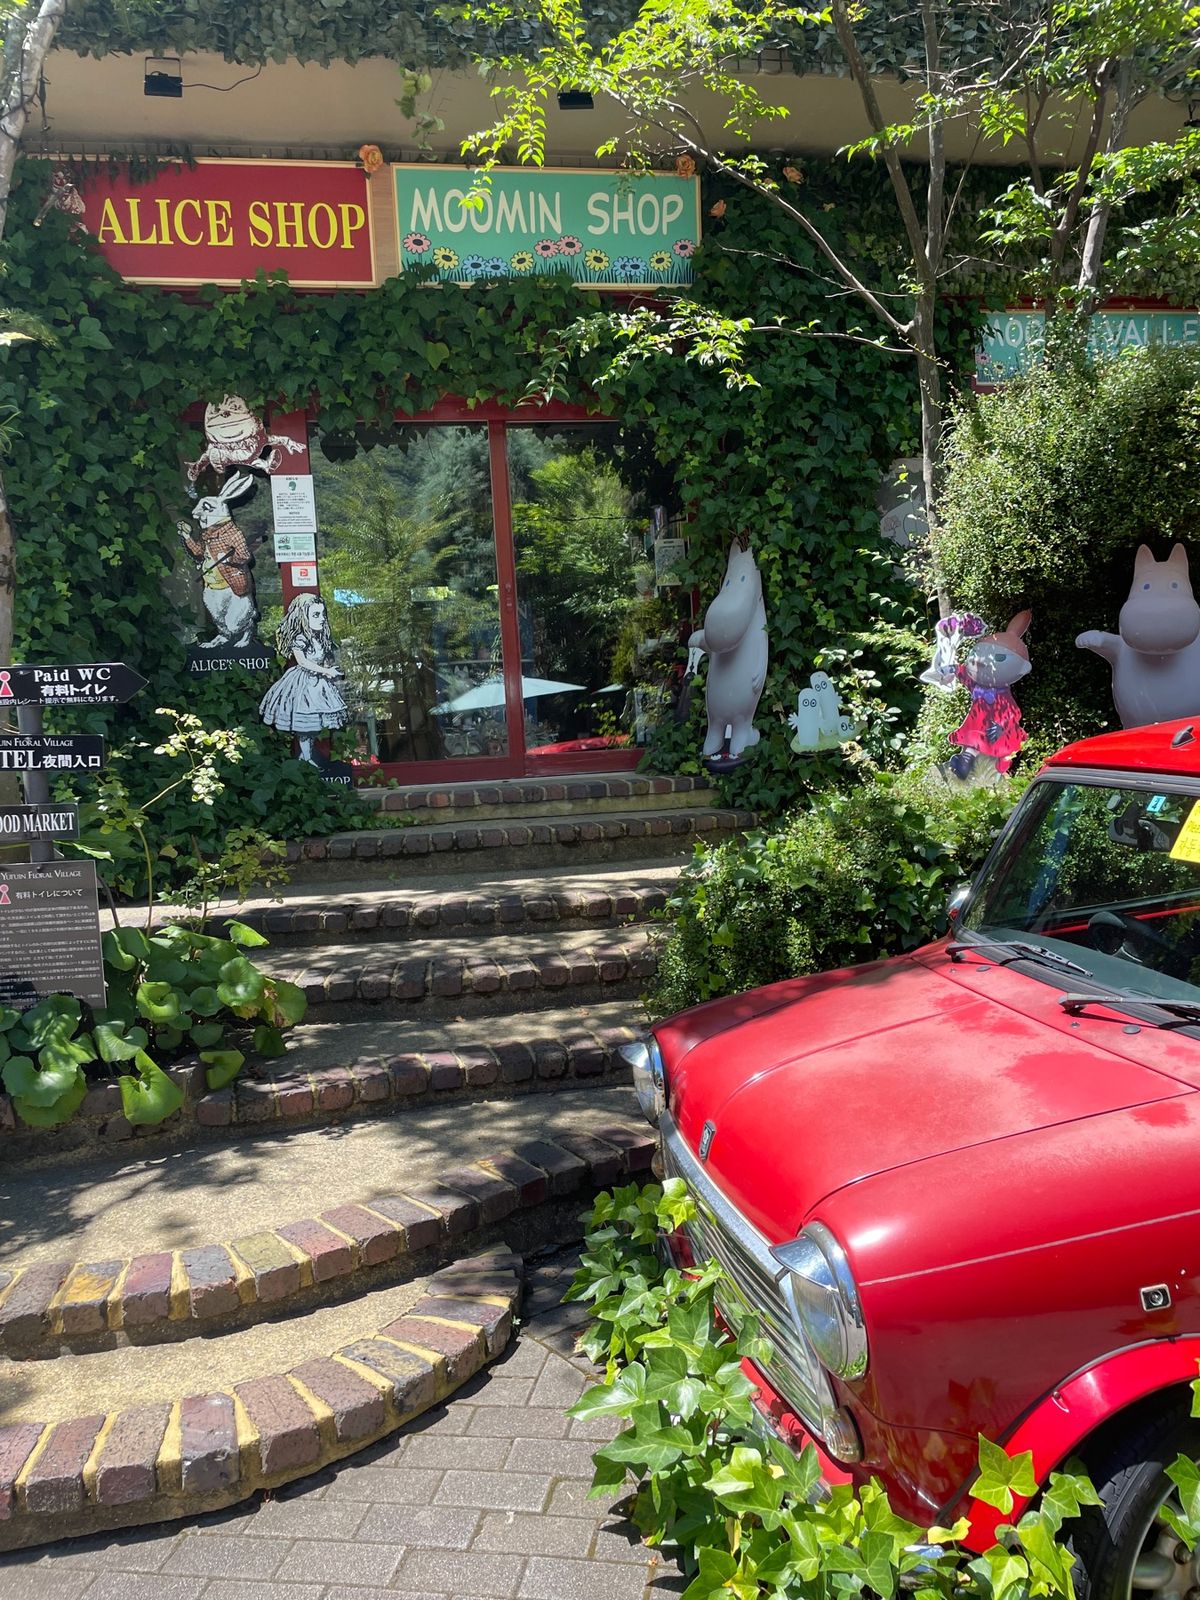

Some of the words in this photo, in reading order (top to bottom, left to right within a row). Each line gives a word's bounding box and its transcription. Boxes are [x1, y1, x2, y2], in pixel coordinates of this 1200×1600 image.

[410, 187, 563, 234] MOOMIN
[587, 192, 684, 236] SHOP
[97, 197, 234, 247] ALICE
[248, 200, 366, 249] SHOP
[34, 669, 70, 683] Paid
[77, 667, 112, 681] WC
[41, 684, 108, 697] 有料トイレ
[14, 737, 42, 747] FLORAL
[43, 737, 74, 747] VILLAGE
[0, 750, 41, 768] TEL
[43, 754, 101, 768] 夜間入口
[23, 812, 75, 833] MARKET
[1, 872, 26, 880] YUFUIN
[28, 870, 52, 879] FLORAL
[54, 869, 81, 878] VILLAGE
[16, 889, 83, 899] 有料トイレについて
